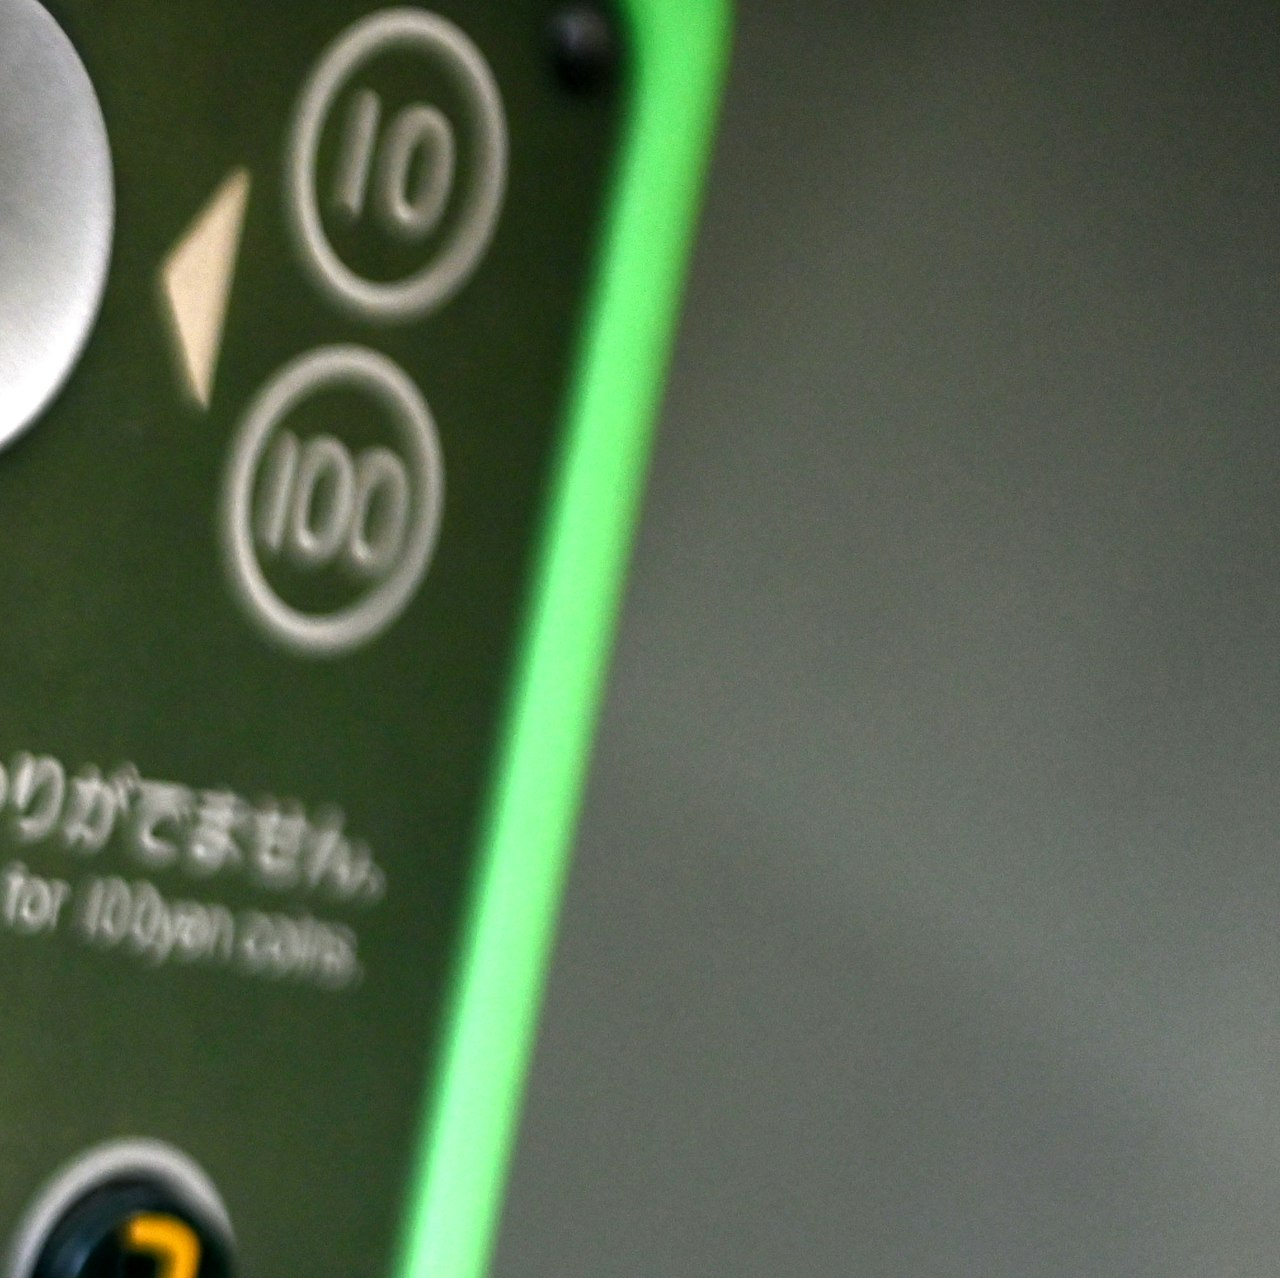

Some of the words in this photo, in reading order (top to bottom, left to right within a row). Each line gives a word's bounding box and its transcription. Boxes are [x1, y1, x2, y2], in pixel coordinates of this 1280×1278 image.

[336, 88, 456, 236] 10
[263, 431, 412, 577] 100
[1, 860, 70, 934] for
